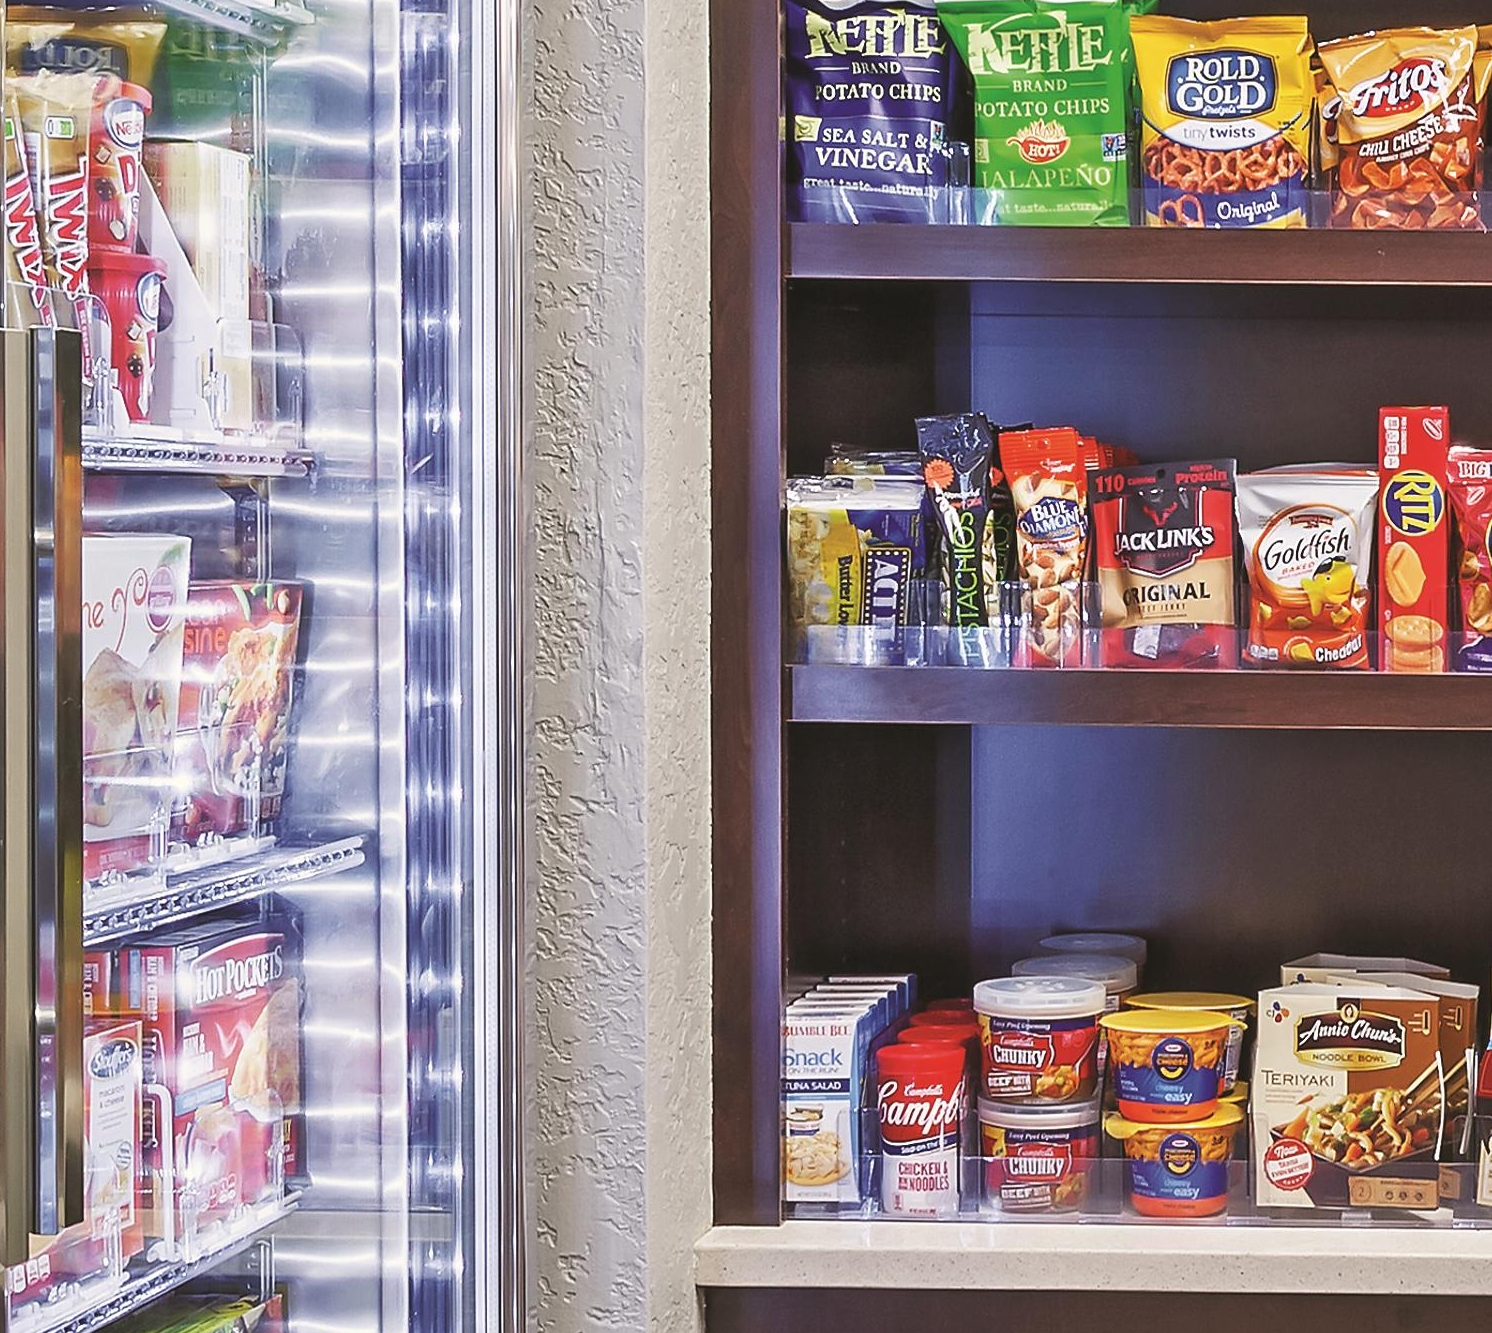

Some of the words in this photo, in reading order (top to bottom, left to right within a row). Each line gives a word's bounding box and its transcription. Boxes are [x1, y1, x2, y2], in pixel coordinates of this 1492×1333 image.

[805, 8, 946, 60] KETTLE
[963, 10, 1114, 74] KETTLE
[852, 62, 901, 75] BRAND
[1187, 56, 1260, 81] ROLD
[815, 83, 882, 102] POTATO
[890, 85, 941, 102] CHIPS
[1013, 78, 1067, 93] BRAND
[1176, 80, 1266, 111] GOLD
[975, 101, 1046, 118] POTATO
[1054, 99, 1109, 115] CHIPS
[822, 127, 857, 143] SEA
[862, 129, 910, 148] SALT
[914, 134, 927, 149] &
[1183, 126, 1206, 140] tiny
[1209, 126, 1256, 140] twists
[815, 148, 933, 175] VINEGAR
[1216, 193, 1278, 220] Original
[1265, 531, 1351, 576] Goldfish
[195, 966, 223, 1003] HOT
[225, 945, 283, 995] POCKETS
[1312, 1053, 1353, 1065] NOODLE
[1357, 1054, 1386, 1065] BOWL
[1260, 1069, 1335, 1088] TERIYAKI
[909, 1176, 949, 1191] NOODLES
